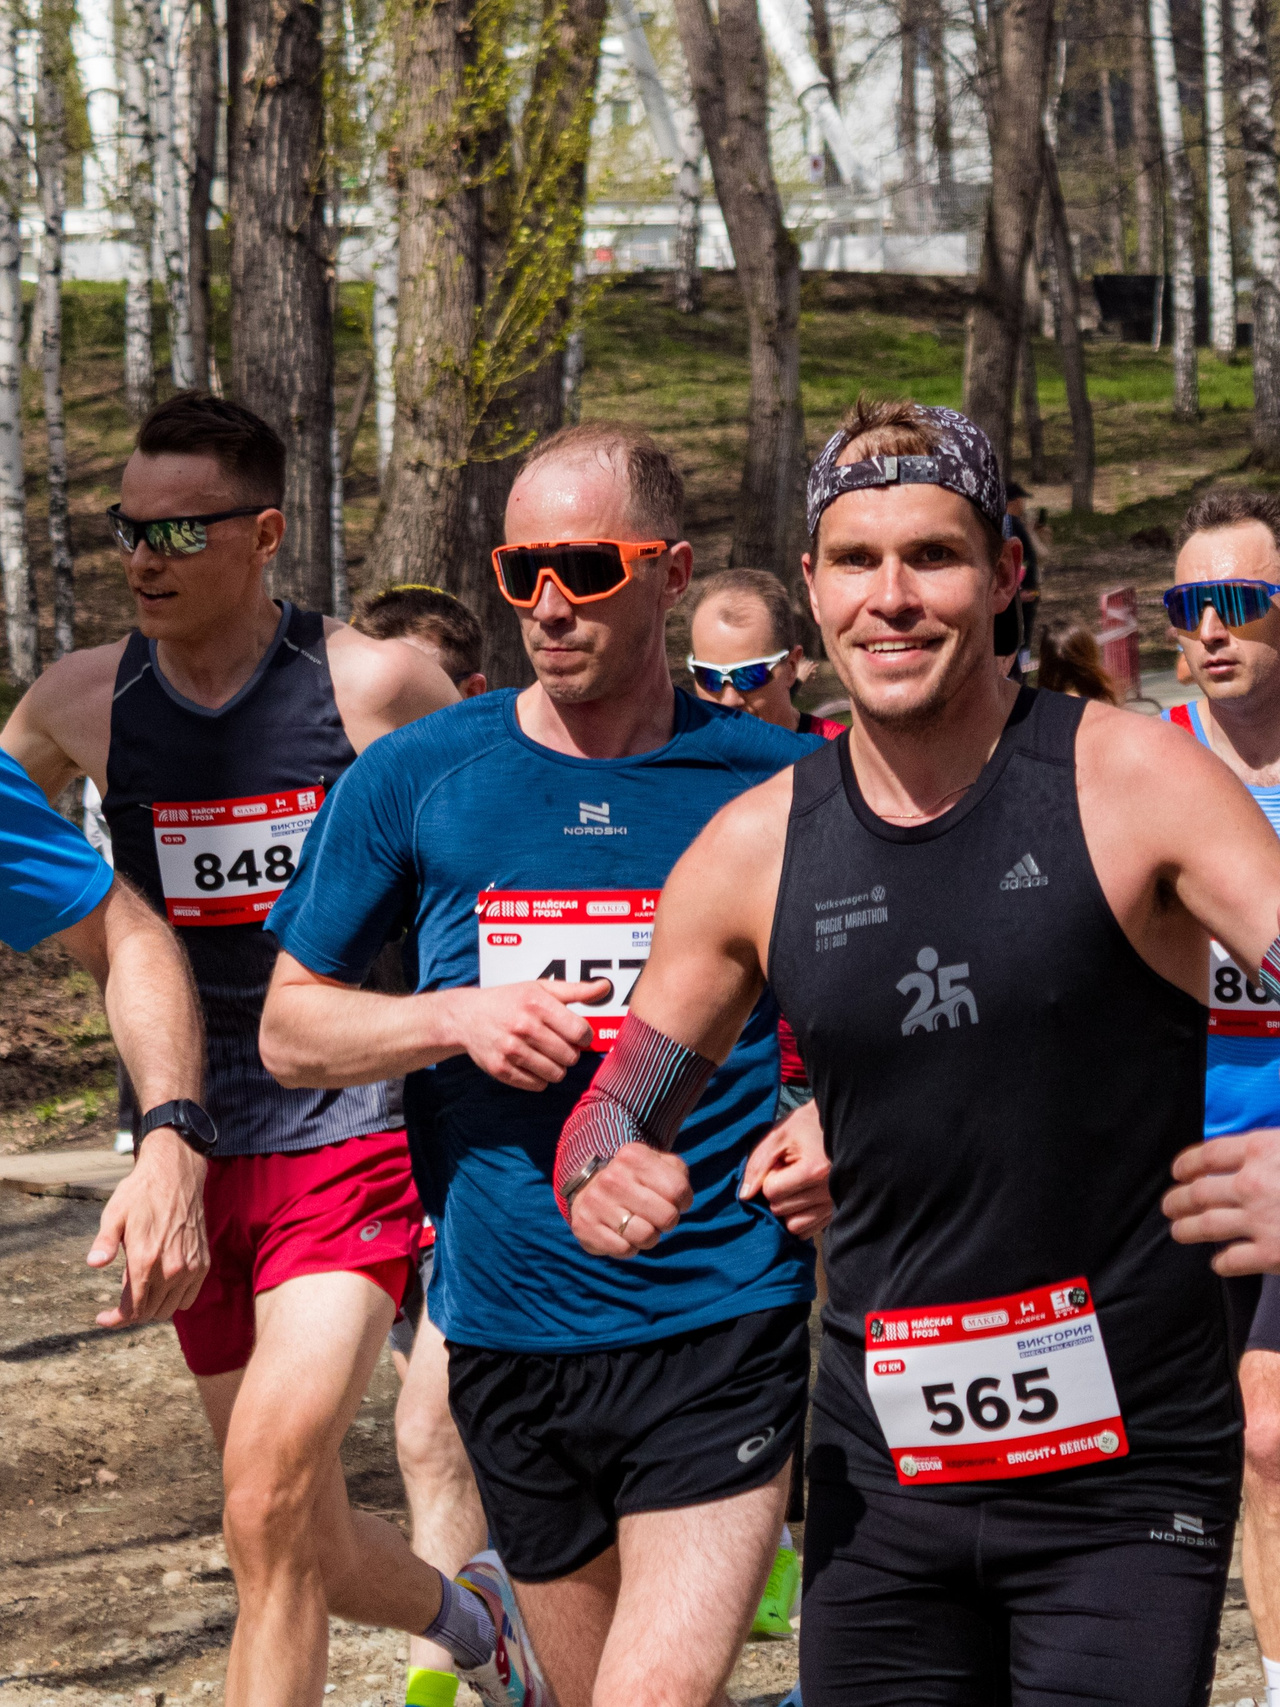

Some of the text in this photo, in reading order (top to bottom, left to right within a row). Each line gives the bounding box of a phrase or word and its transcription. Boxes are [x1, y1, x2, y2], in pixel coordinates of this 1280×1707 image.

[191, 806, 226, 815] МАЙСКАЯ
[563, 826, 628, 836] NORDSKI
[193, 845, 297, 892] 848
[1000, 875, 1049, 891] adidas
[253, 901, 276, 912] BRIG
[532, 899, 578, 909] МАЙСКАЯ
[815, 893, 869, 911] Volkswagen
[532, 909, 563, 918] ГРОЗА
[815, 906, 888, 937] PRAGUE MARATHON
[491, 935, 502, 944] 10
[911, 1315, 953, 1329] МАЙСКАЯ
[967, 1313, 1004, 1328] MAKFA
[1014, 1312, 1046, 1326] HARPER
[911, 1328, 940, 1339] ГРОЗА
[1016, 1324, 1093, 1350] ВИКТОРИЯ
[877, 1364, 887, 1373] 10
[921, 1367, 1059, 1437] 565
[915, 1461, 943, 1471] EEDOM
[1006, 1446, 1050, 1465] BRIGHT
[1059, 1434, 1101, 1456] BERGAU
[1149, 1530, 1217, 1546] NORDSKI
